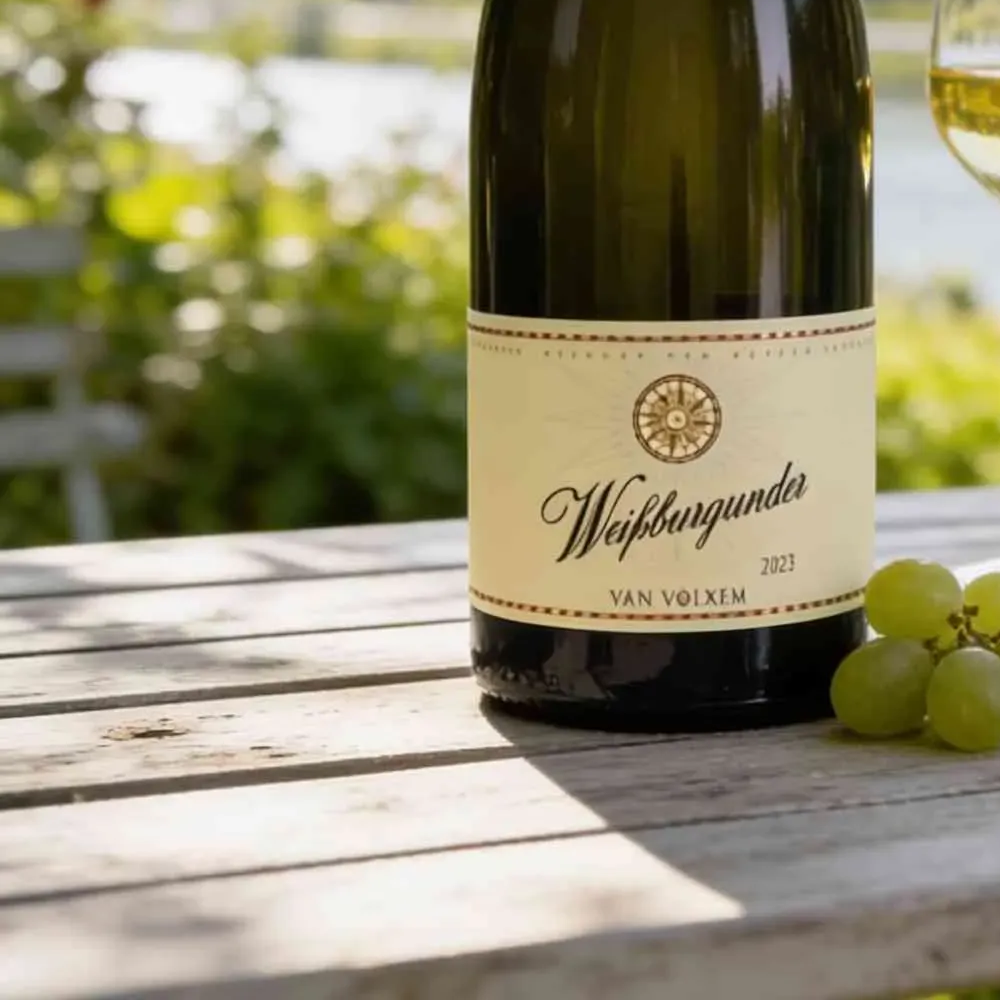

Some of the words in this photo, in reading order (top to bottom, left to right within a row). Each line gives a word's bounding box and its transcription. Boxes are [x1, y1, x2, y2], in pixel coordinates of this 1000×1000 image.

[541, 461, 807, 563] Weißburgunder
[760, 553, 796, 576] 2023
[610, 589, 652, 607] VAN
[662, 587, 747, 608] VOLXEM
